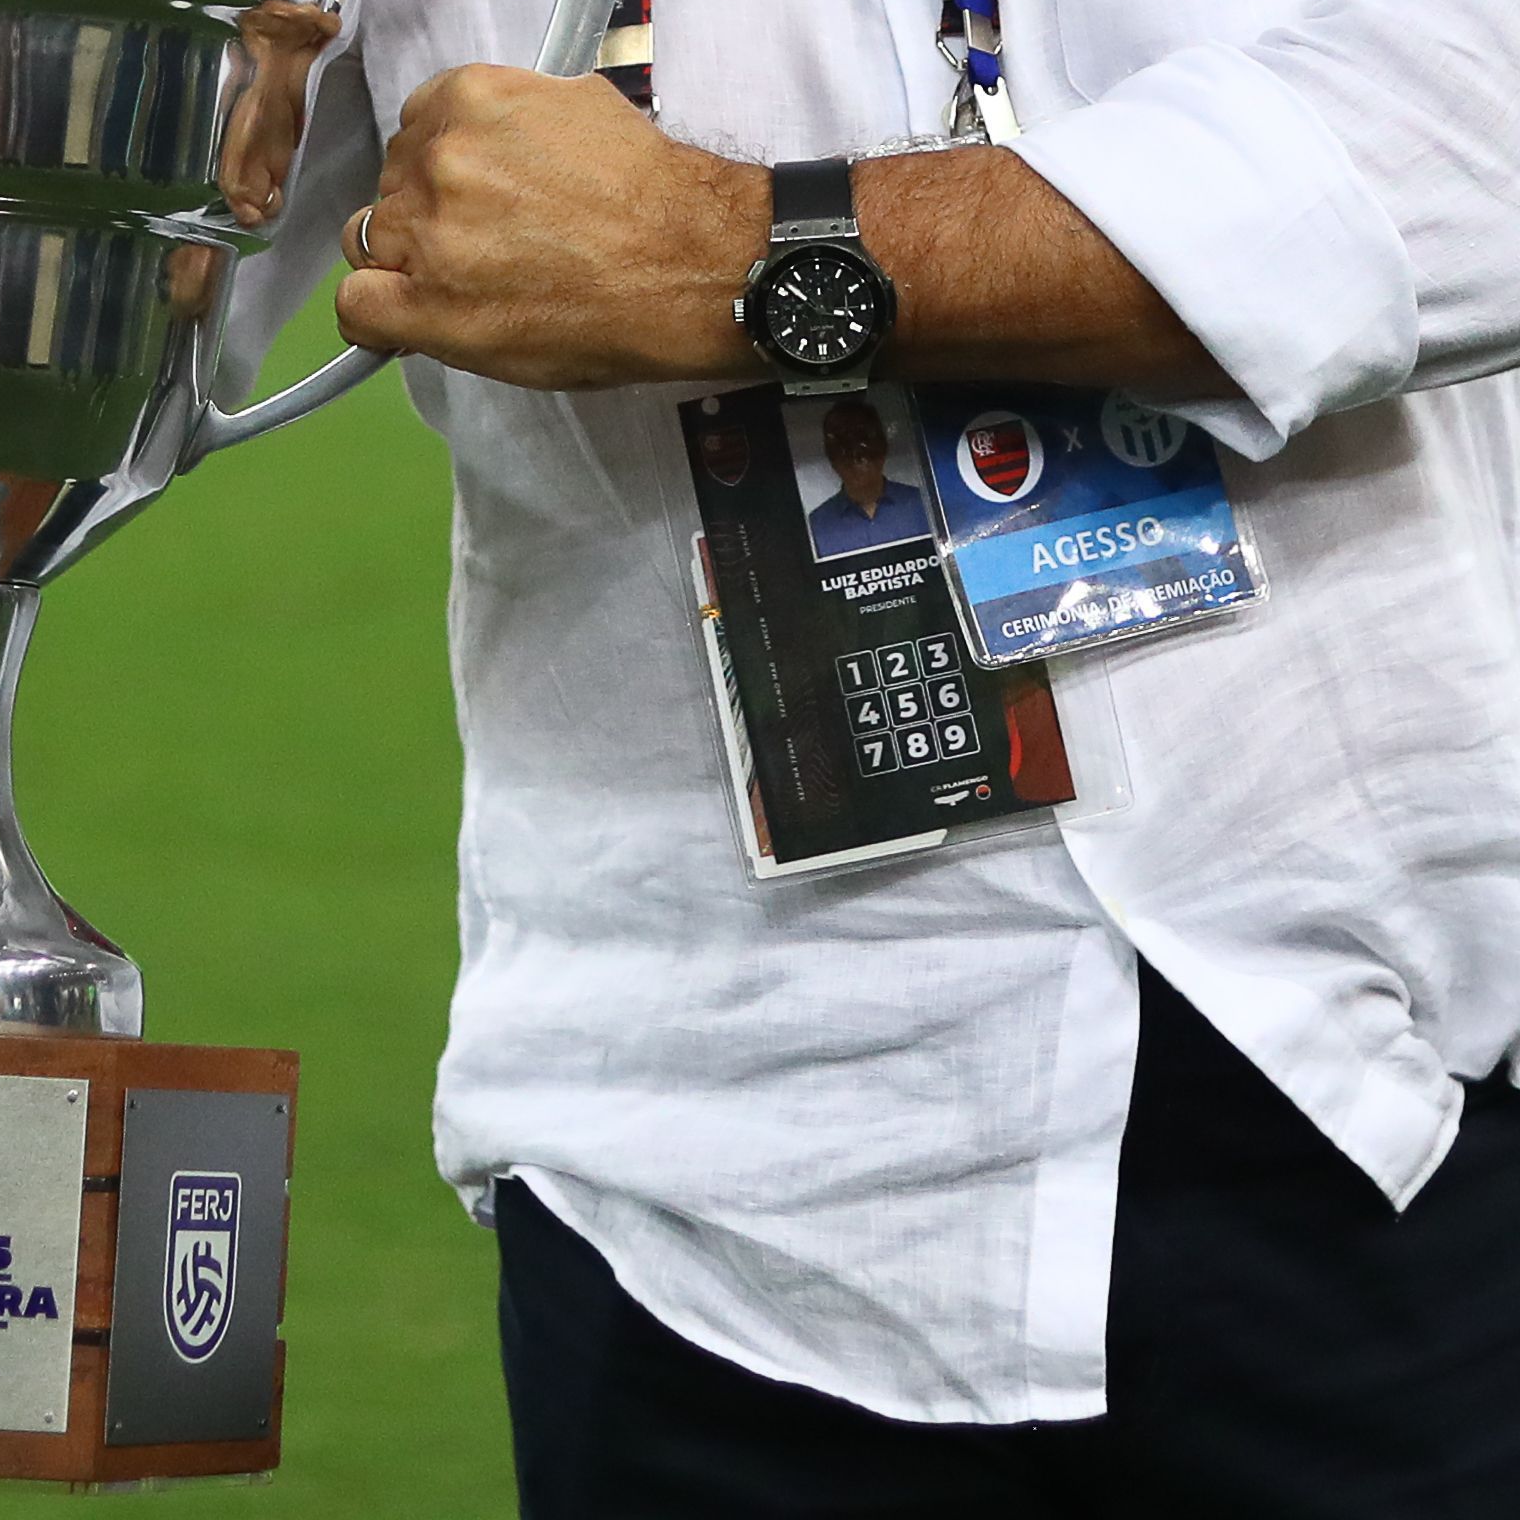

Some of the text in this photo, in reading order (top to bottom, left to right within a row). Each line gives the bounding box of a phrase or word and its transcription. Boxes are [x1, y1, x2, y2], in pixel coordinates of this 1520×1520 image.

[1032, 516, 1164, 574] ACESSO
[821, 555, 940, 592] LUIZ EDUARDO
[844, 572, 924, 600] BAPTISTA
[1138, 569, 1235, 605] REMIAÇÃO
[860, 595, 917, 615] PRESIDENTE
[846, 642, 949, 686] 1 2 3
[858, 683, 960, 725] 4 5 6
[863, 725, 966, 767] 7 8 9
[942, 775, 989, 790] FLAMENGO
[176, 1188, 233, 1222] FERJ
